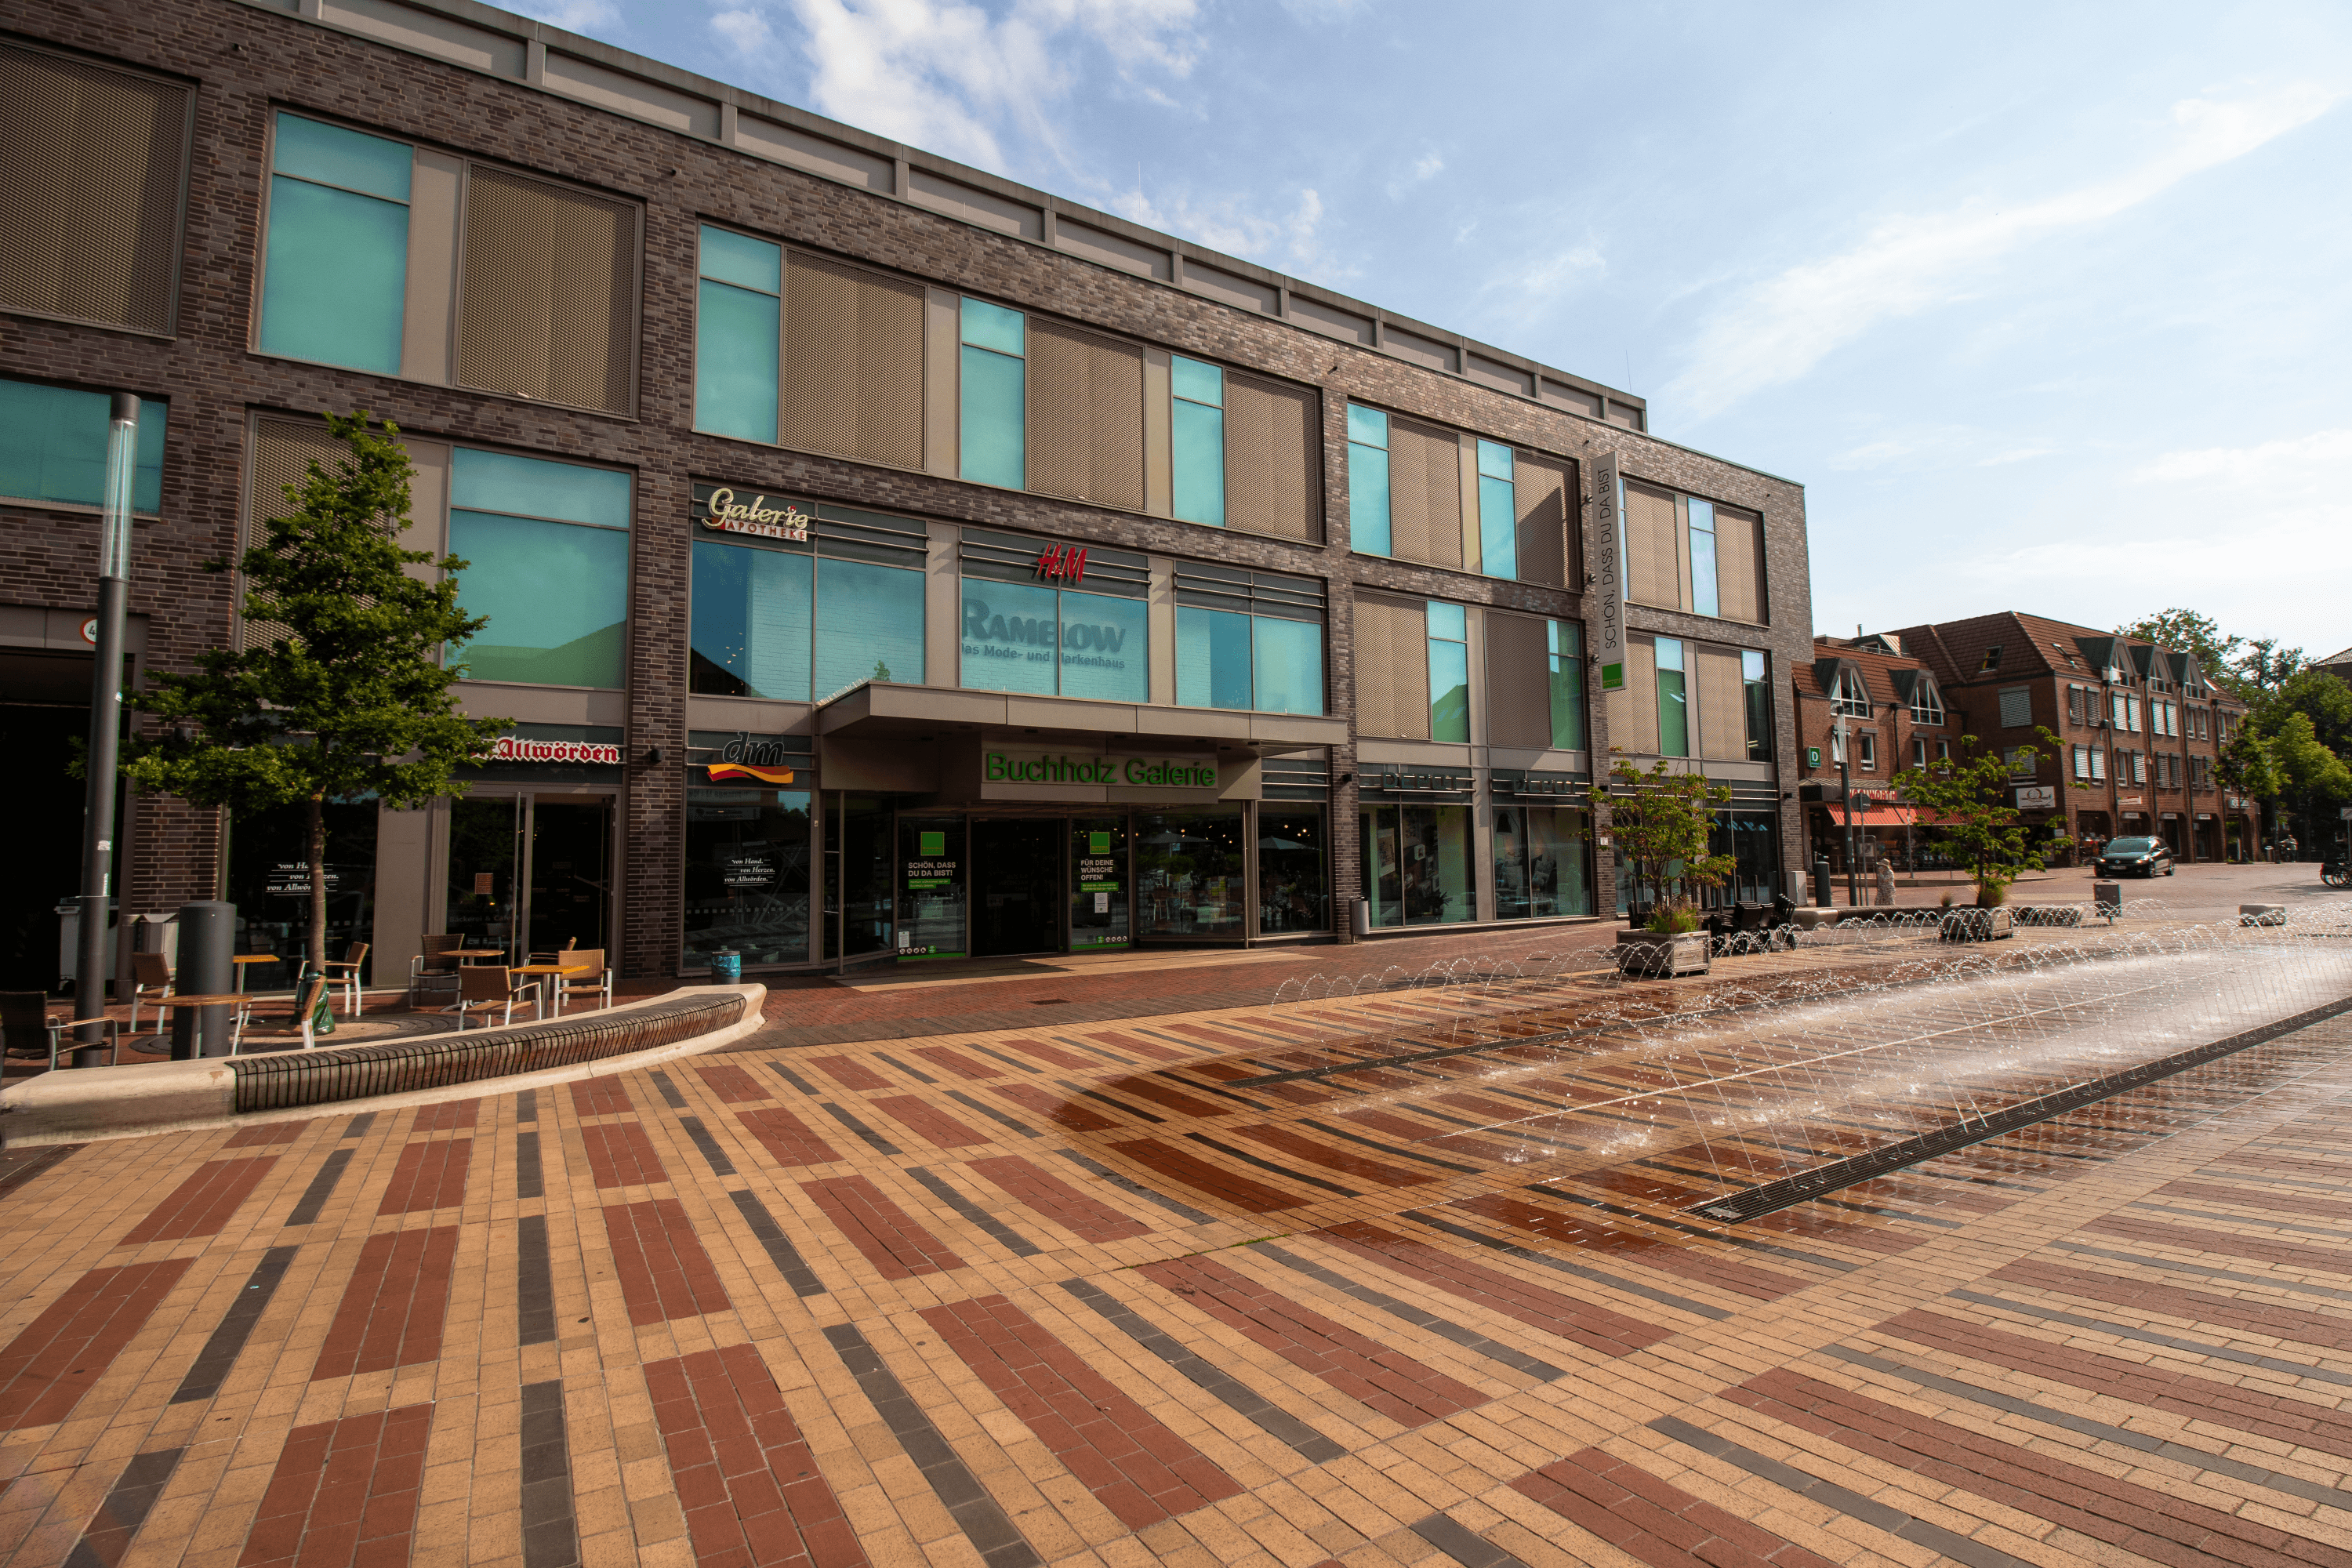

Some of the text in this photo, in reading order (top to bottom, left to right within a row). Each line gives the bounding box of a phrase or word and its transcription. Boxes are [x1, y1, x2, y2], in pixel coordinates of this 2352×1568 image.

[702, 488, 809, 529] Galerie
[727, 521, 806, 540] APOTHEKE
[1036, 543, 1088, 583] H&M
[1598, 468, 1617, 649] SCHÖN, DASS DU DA BIST
[984, 645, 1024, 659] Mode-
[1028, 652, 1050, 662] und
[1061, 652, 1125, 669] arkenhaus
[496, 735, 620, 764] Allwörden
[723, 731, 785, 764] dm
[988, 753, 1216, 786] Buchholz Galerie
[908, 861, 935, 869] SCHÖN,
